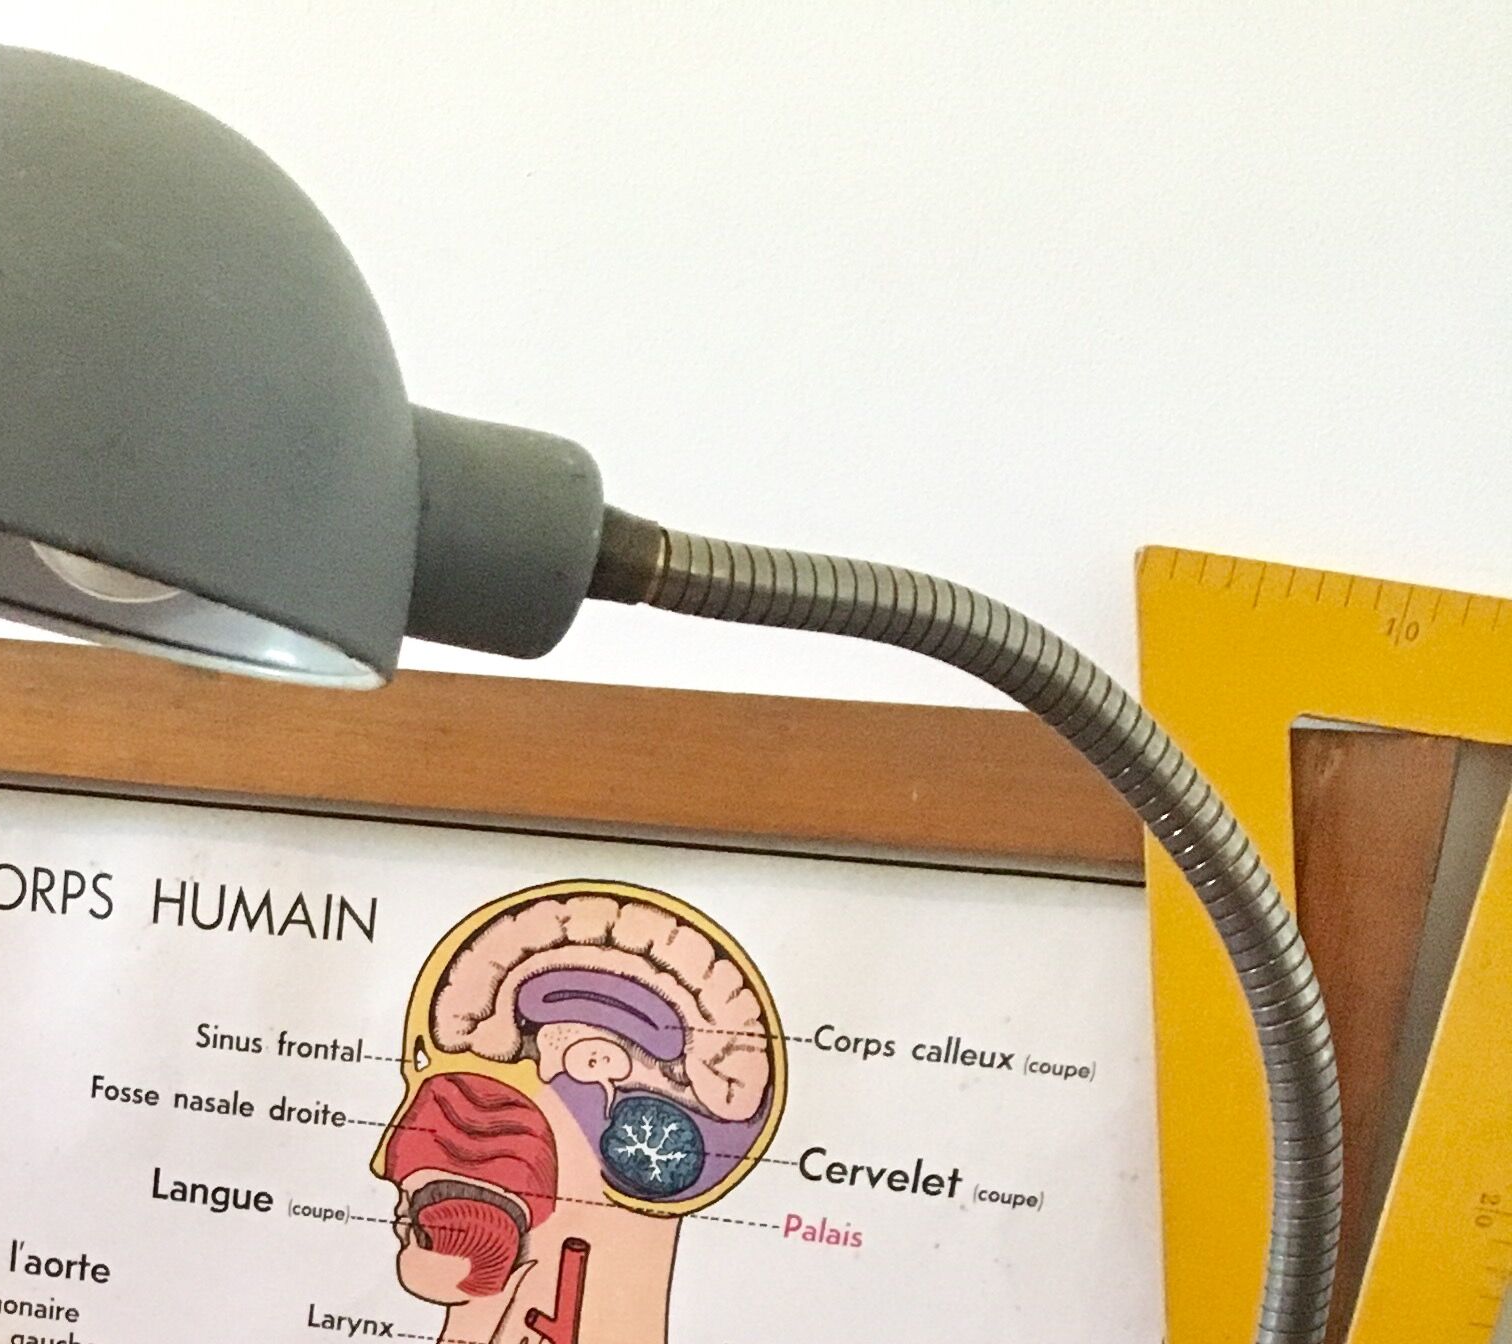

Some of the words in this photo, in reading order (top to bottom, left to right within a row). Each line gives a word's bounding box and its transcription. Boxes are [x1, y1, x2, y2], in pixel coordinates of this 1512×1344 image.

[151, 877, 379, 943] HUMAIN
[194, 1022, 263, 1055] Sinus
[276, 1030, 363, 1064] frontal
[813, 1024, 897, 1062] Corps
[911, 1037, 1015, 1072] calleux
[1023, 1055, 1096, 1083] (coupe)
[90, 1075, 160, 1107] Fosse
[172, 1088, 255, 1118] nasale
[268, 1099, 348, 1129] droite
[151, 1168, 274, 1219] Langue
[286, 1197, 351, 1224] (coupe)
[797, 1147, 963, 1199] Cervelet
[972, 1183, 1044, 1211] (coupe)
[782, 1216, 864, 1249] Palais
[9, 1240, 112, 1285] l'aorte
[307, 1303, 394, 1341] Larynx
